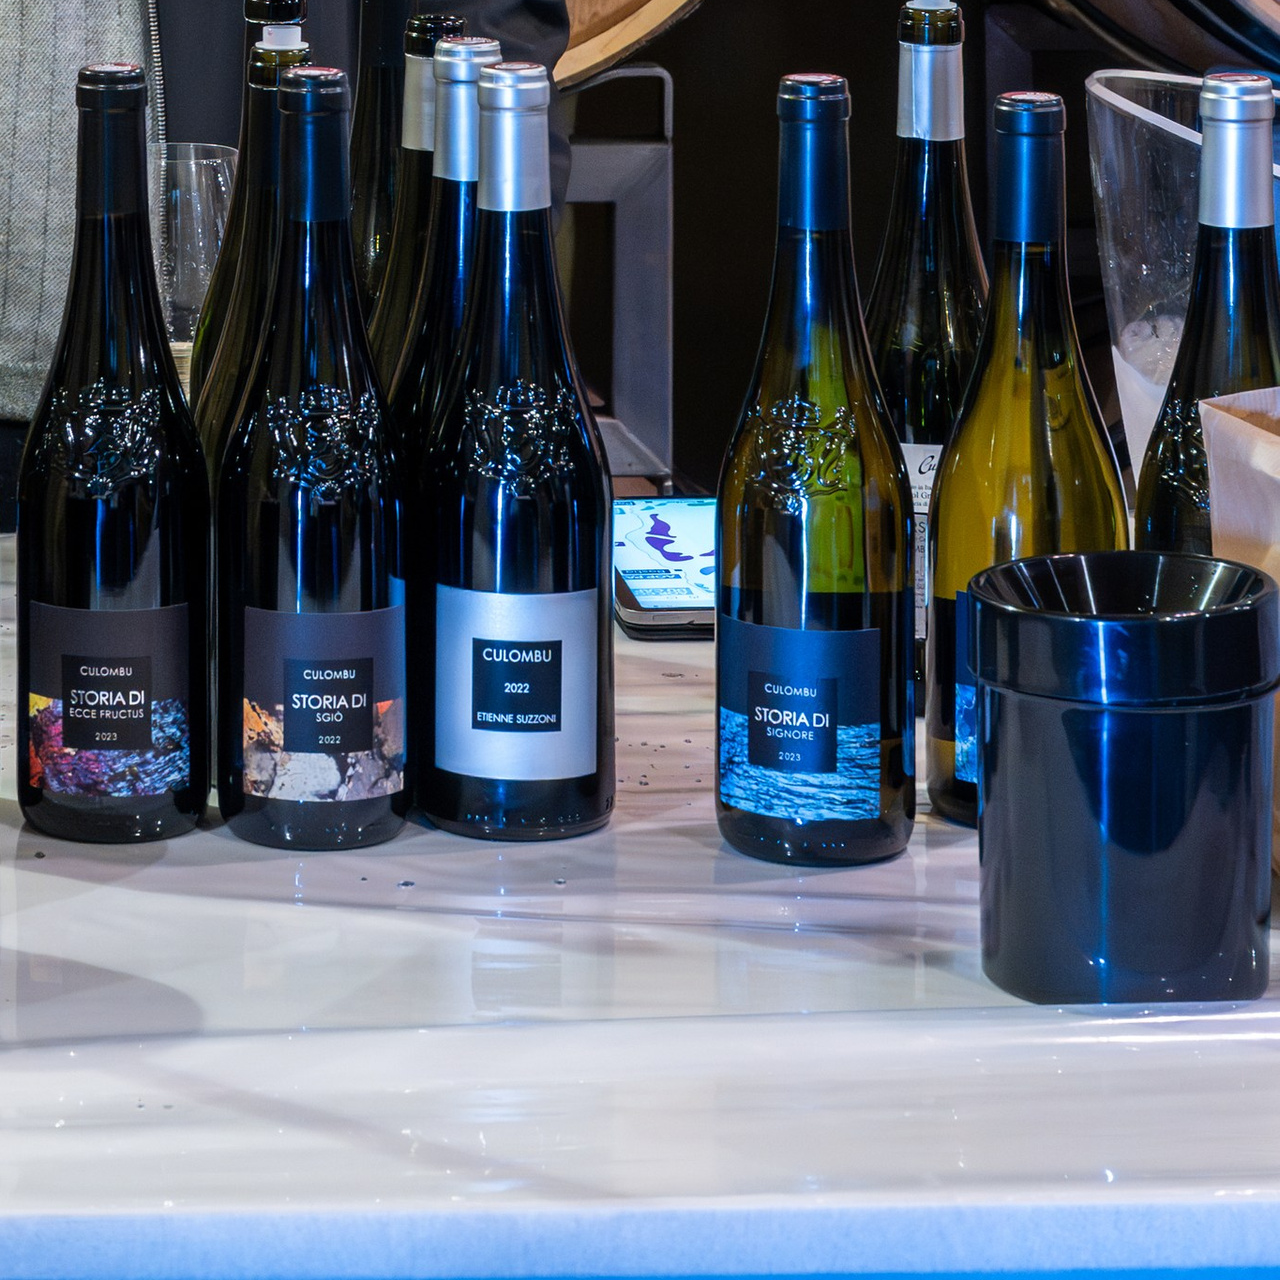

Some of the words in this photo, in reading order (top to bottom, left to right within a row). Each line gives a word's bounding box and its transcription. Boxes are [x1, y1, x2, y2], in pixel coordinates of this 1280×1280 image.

[482, 647, 552, 663] CULOMBU
[80, 665, 133, 677] CULOMBU
[303, 669, 356, 680] CULOMBU
[504, 682, 530, 694] 2022
[764, 683, 817, 698] CULOMBU
[70, 689, 126, 706] STORIA
[129, 690, 145, 705] DI
[292, 693, 349, 710] STORIA
[352, 693, 367, 708] DI
[69, 707, 97, 719] ECCE
[100, 708, 144, 719] FRUCTUS
[316, 711, 343, 723] SGIÒ
[477, 711, 514, 724] ETIENNE
[516, 713, 557, 725] SUZZONI
[754, 706, 810, 727] STORIA
[813, 713, 830, 728] DI
[95, 732, 118, 741] 2023
[766, 726, 814, 740] SIGNORE
[318, 735, 341, 744] 2022
[778, 751, 802, 762] 2023
